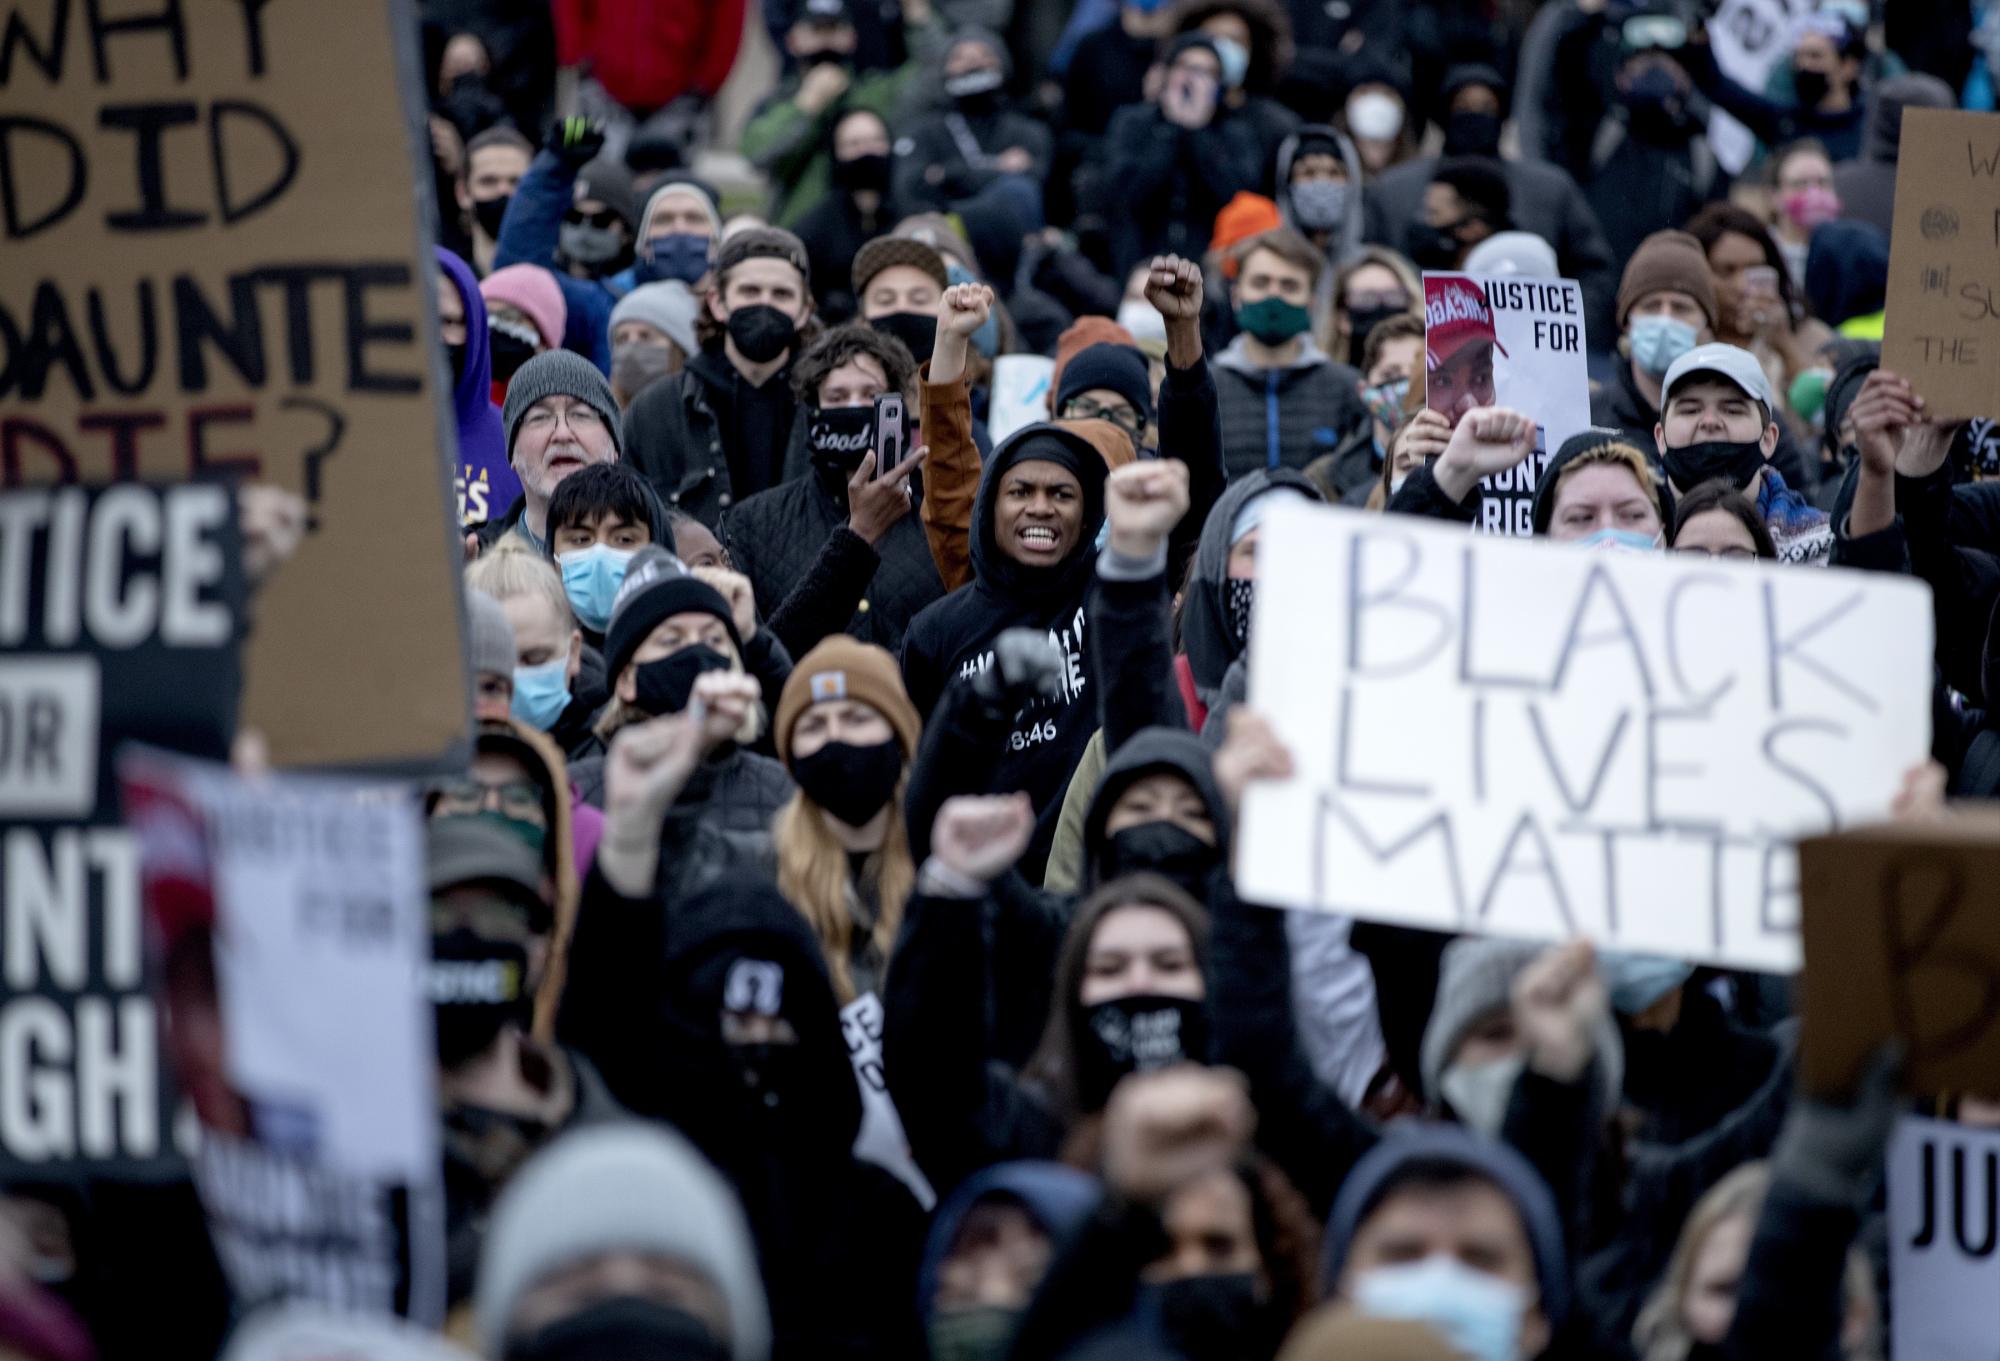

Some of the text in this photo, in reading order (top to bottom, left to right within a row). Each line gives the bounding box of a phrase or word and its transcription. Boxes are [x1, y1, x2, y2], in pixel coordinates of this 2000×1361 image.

[3, 98, 302, 239] DID
[1479, 281, 1577, 315] JUSTICE
[1534, 321, 1578, 352] FOR
[1914, 335, 1980, 367] THE
[811, 422, 871, 451] Good
[1348, 530, 1880, 715] BLACK
[1011, 718, 1056, 750] 8:46
[1337, 685, 1851, 836] LIVES
[1910, 1141, 1999, 1260] JU
